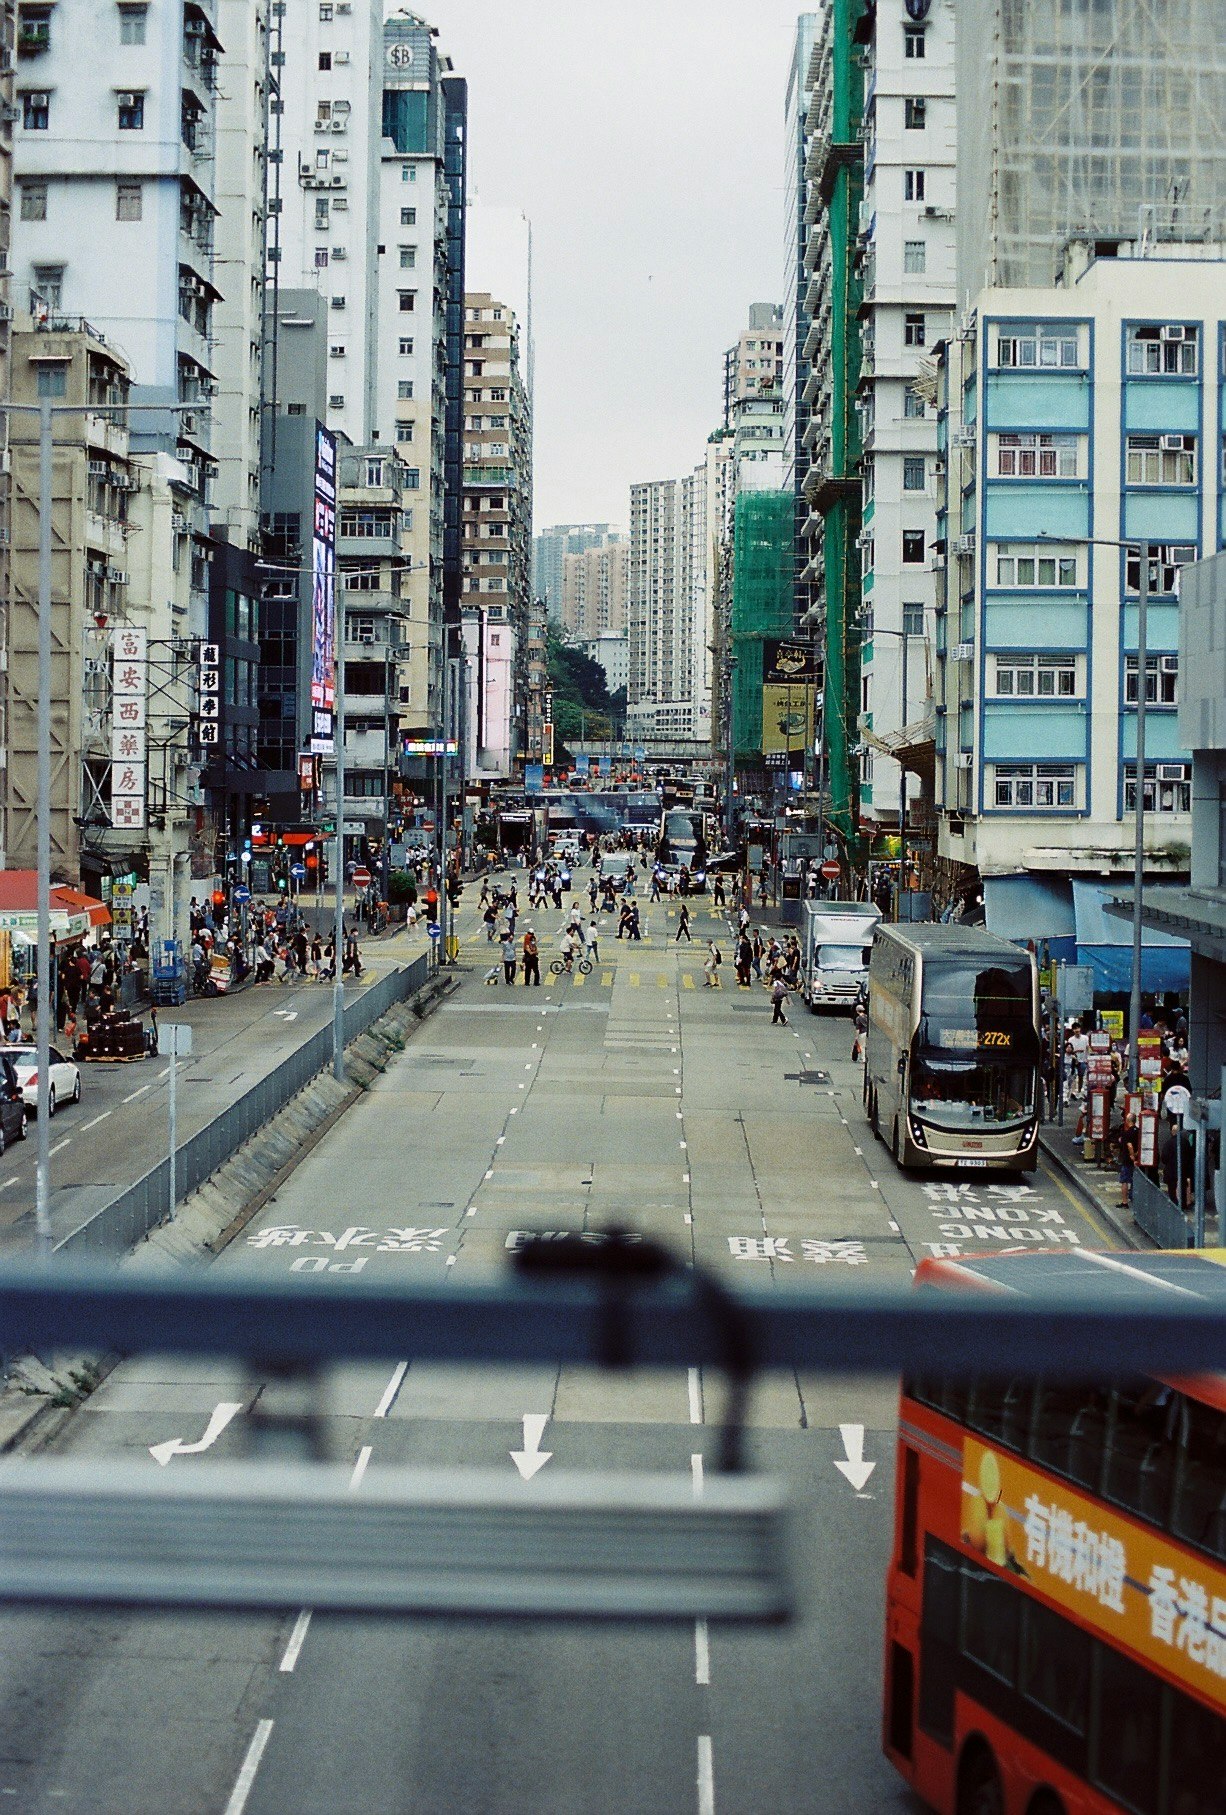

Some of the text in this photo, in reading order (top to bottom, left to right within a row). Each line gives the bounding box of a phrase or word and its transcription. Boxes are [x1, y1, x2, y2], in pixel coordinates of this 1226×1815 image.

[201, 646, 217, 743] 龍形拳館
[118, 633, 142, 792] 富安西藥房
[929, 1205, 1064, 1223] KONG
[246, 1223, 450, 1252] 深水埗
[939, 1224, 1081, 1244] HONG
[727, 1236, 869, 1265] 葵涌
